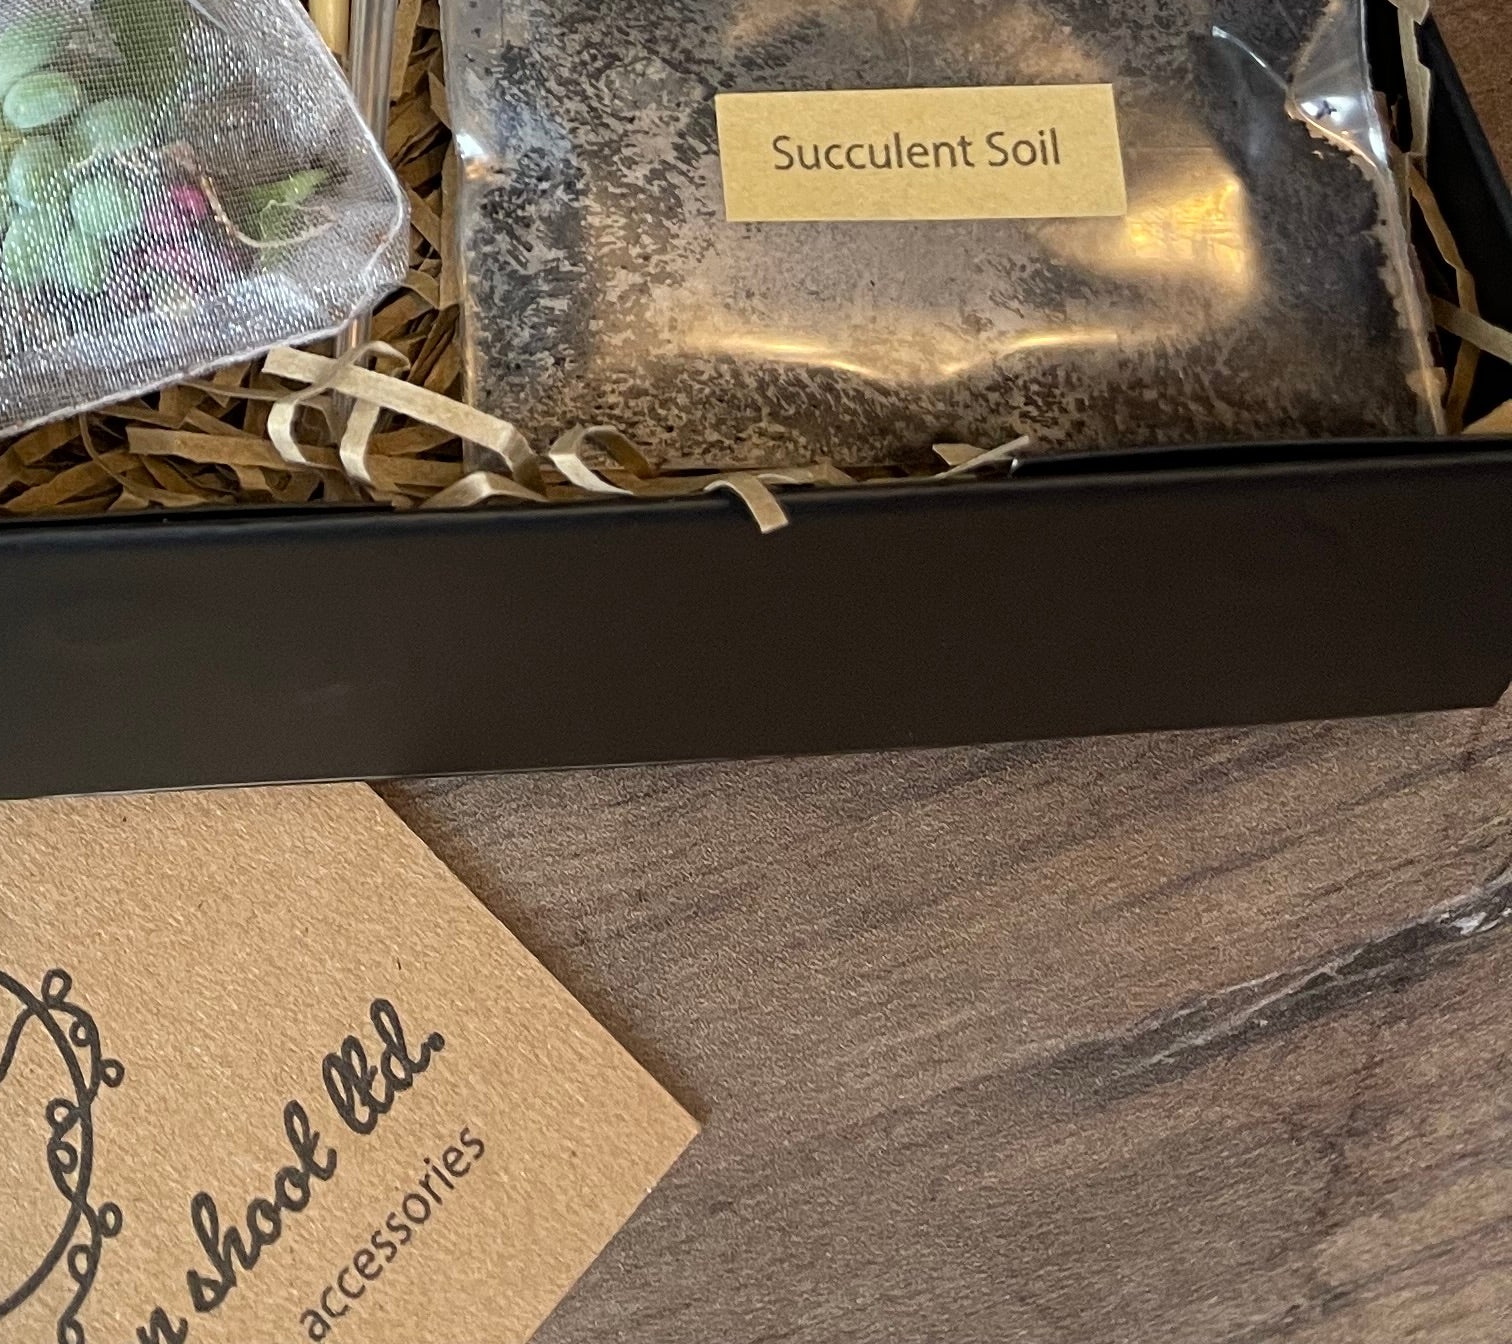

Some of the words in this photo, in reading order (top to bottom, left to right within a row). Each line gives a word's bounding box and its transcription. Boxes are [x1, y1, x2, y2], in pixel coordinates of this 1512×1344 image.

[771, 131, 976, 170] Succulent
[985, 127, 1061, 167] Soil
[186, 1099, 338, 1313] shoot
[322, 997, 446, 1135] ltd.
[299, 1126, 486, 1342] accessories
